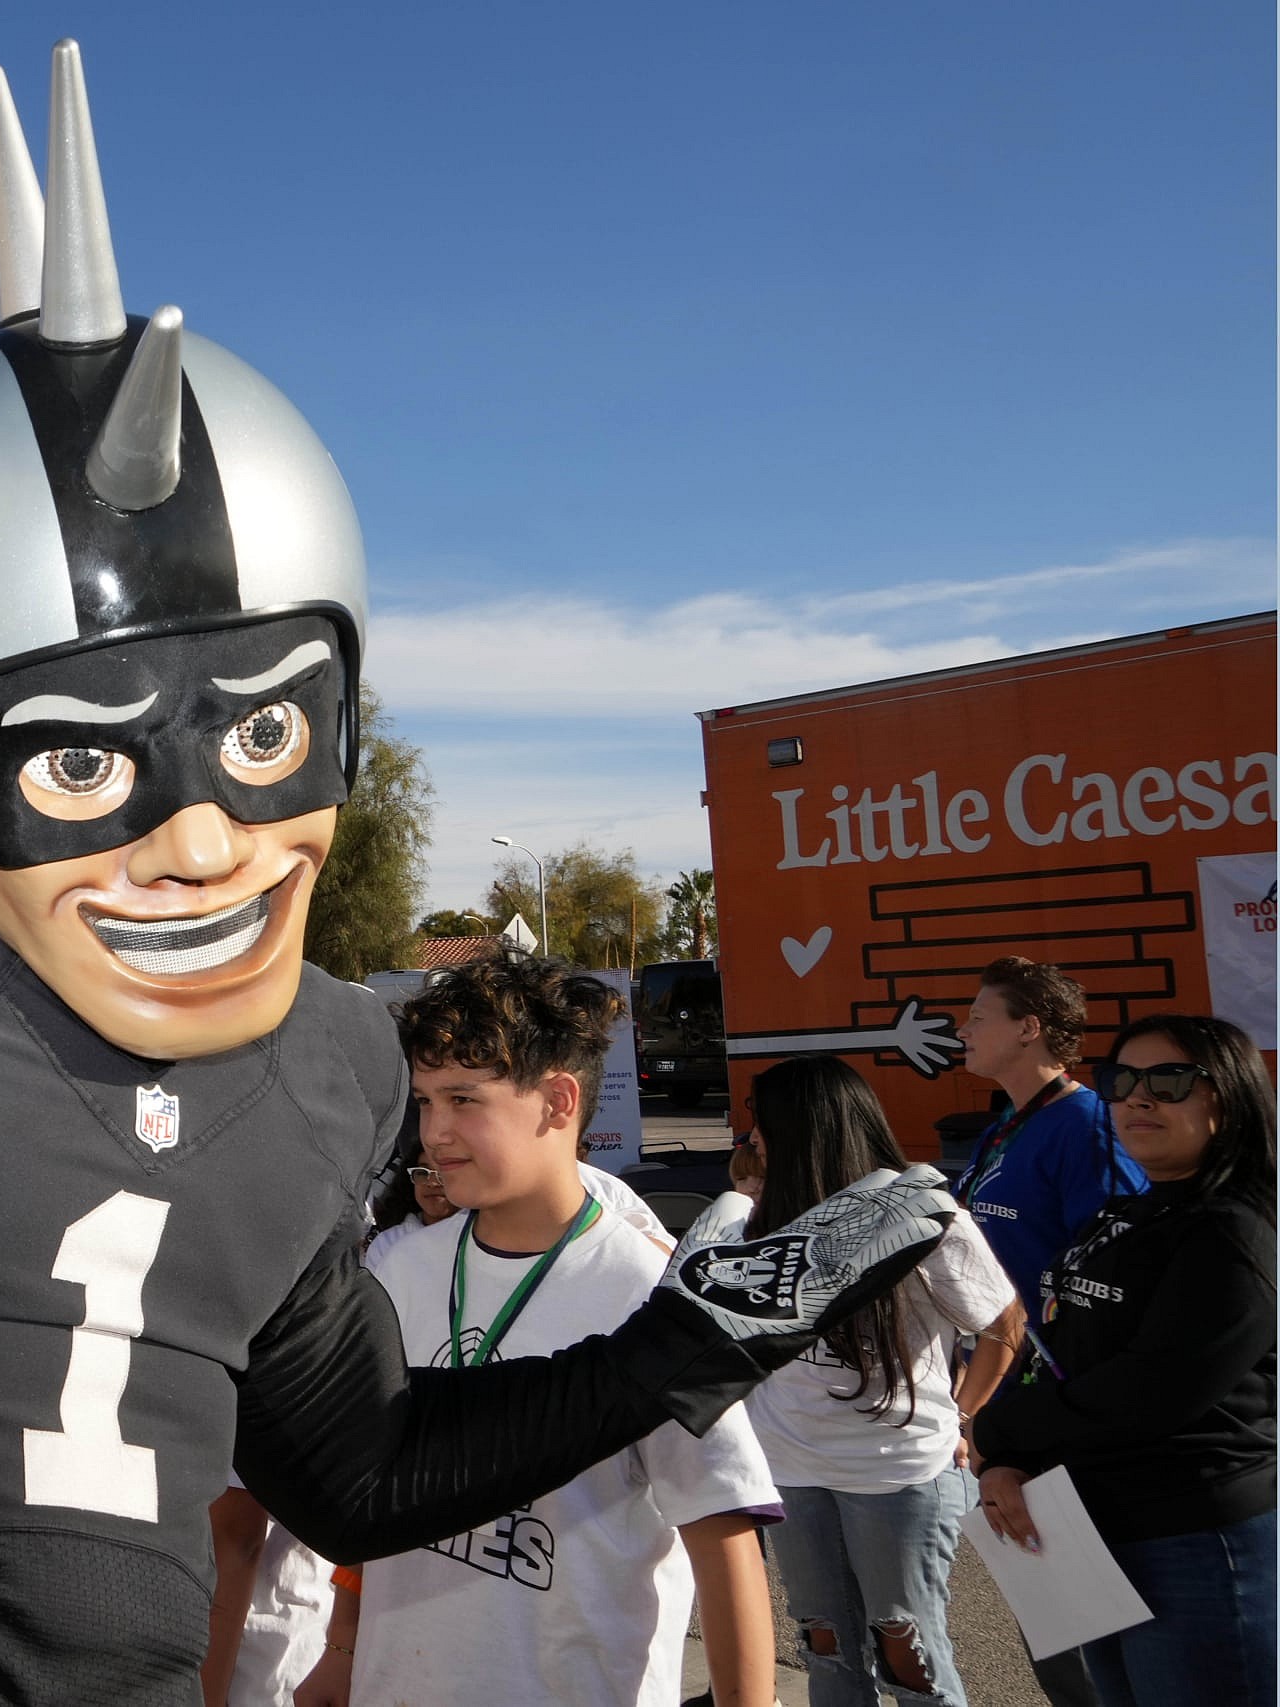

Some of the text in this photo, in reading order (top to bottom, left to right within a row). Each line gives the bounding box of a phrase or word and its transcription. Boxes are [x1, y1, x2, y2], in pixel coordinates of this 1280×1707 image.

[771, 770, 991, 871] Little
[1234, 900, 1277, 917] PRO
[143, 1113, 172, 1140] NFL
[586, 1132, 622, 1142] aesars
[976, 1202, 1018, 1220] CLUBS
[776, 1242, 804, 1308] RAIDERS
[23, 1189, 172, 1524] 1
